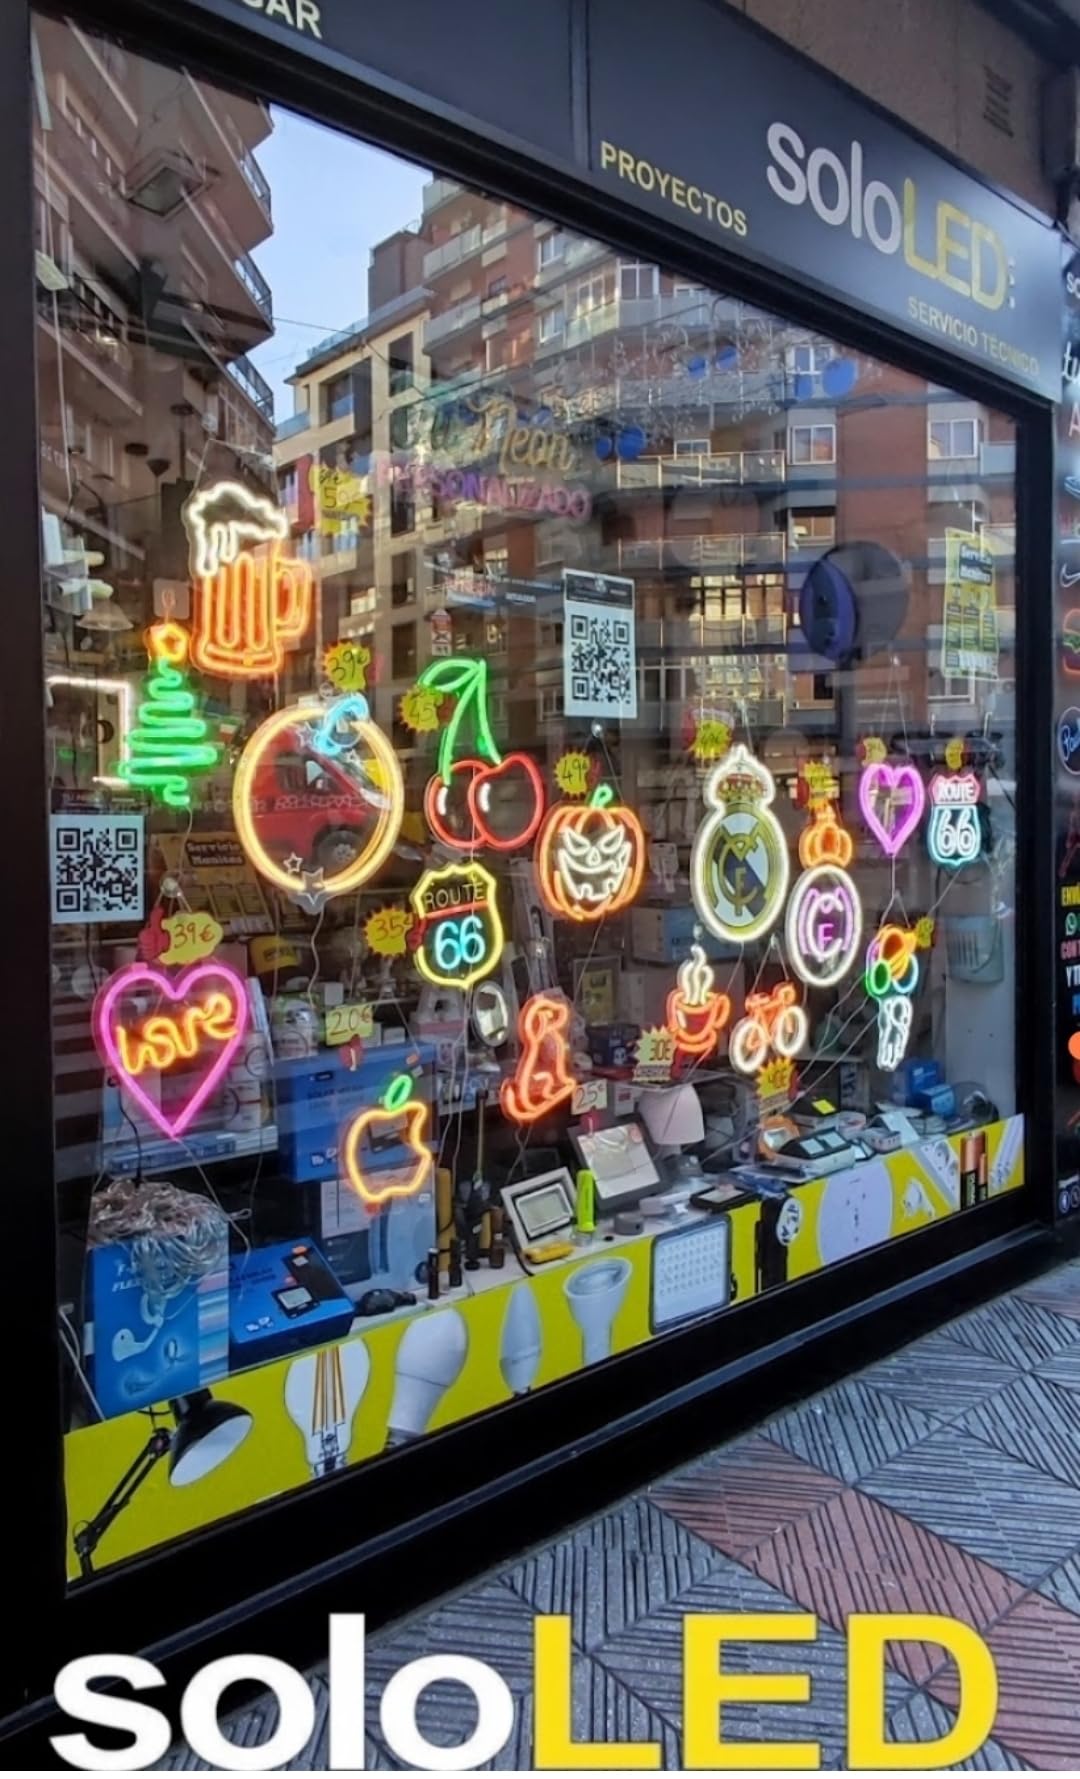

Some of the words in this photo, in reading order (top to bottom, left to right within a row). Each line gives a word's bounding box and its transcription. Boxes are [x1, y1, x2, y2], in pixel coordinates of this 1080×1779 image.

[600, 140, 748, 238] PROYECTOS
[907, 294, 979, 349] SERVICIO
[935, 781, 975, 798] ROUTE
[938, 808, 974, 856] 66
[423, 881, 486, 910] ROUTE
[174, 922, 216, 949] 39€
[434, 914, 487, 970] 66
[328, 1006, 370, 1036] 20€
